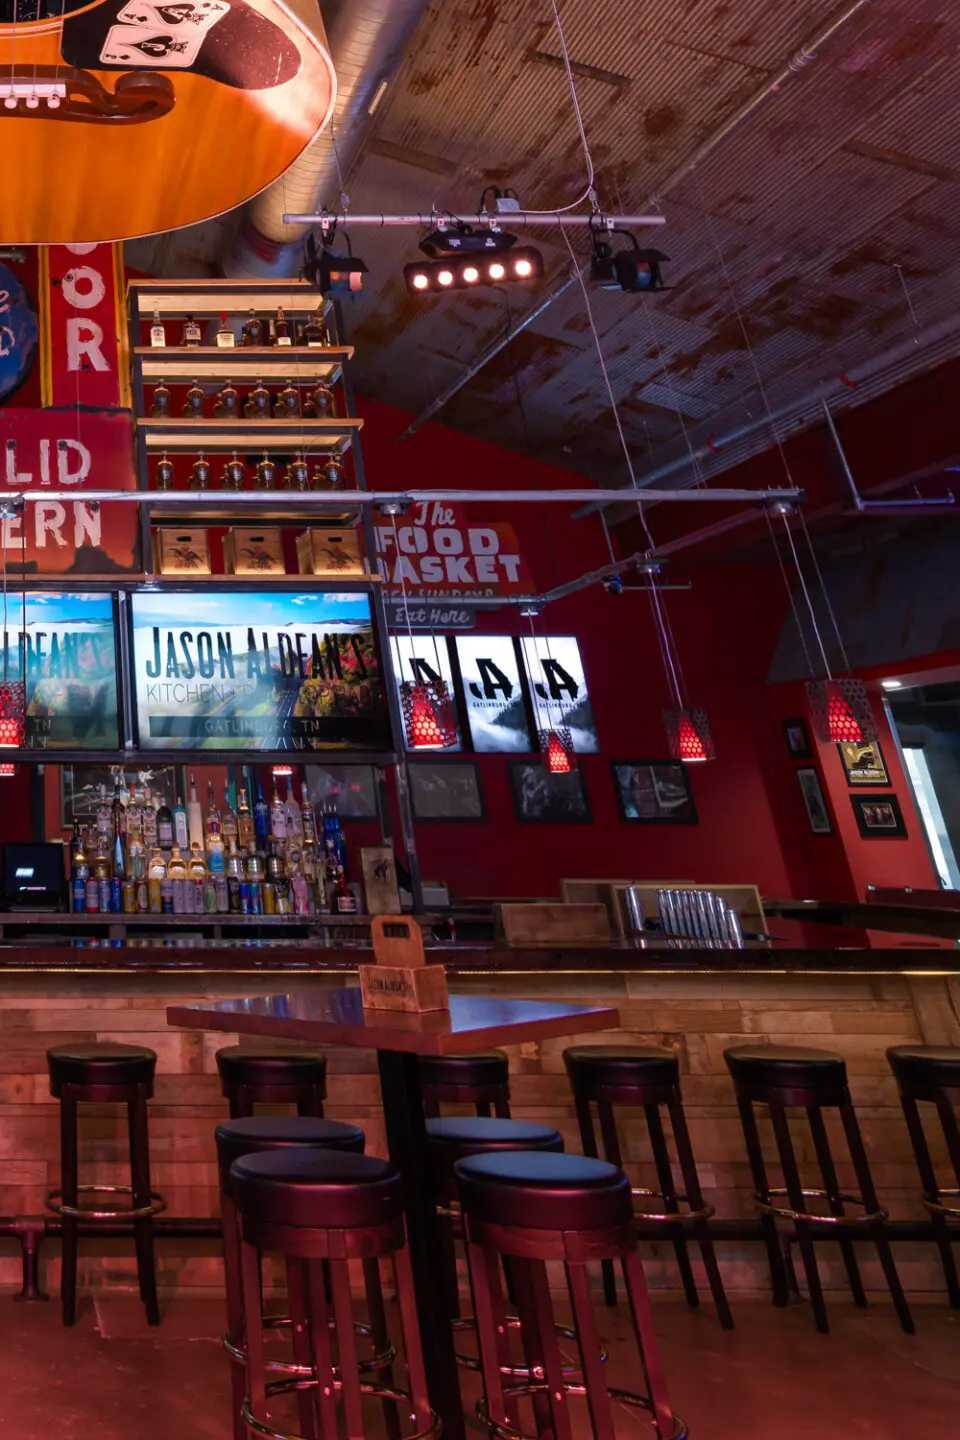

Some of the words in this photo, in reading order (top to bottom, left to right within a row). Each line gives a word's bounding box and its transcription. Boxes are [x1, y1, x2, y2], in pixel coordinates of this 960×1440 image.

[414, 500, 456, 527] The
[374, 527, 499, 555] FOOD
[395, 607, 427, 624] Eat
[430, 608, 471, 624] Here
[145, 626, 235, 680] JASON
[146, 683, 225, 703] KITCHEN
[34, 718, 52, 731] TN
[301, 719, 320, 732] TN
